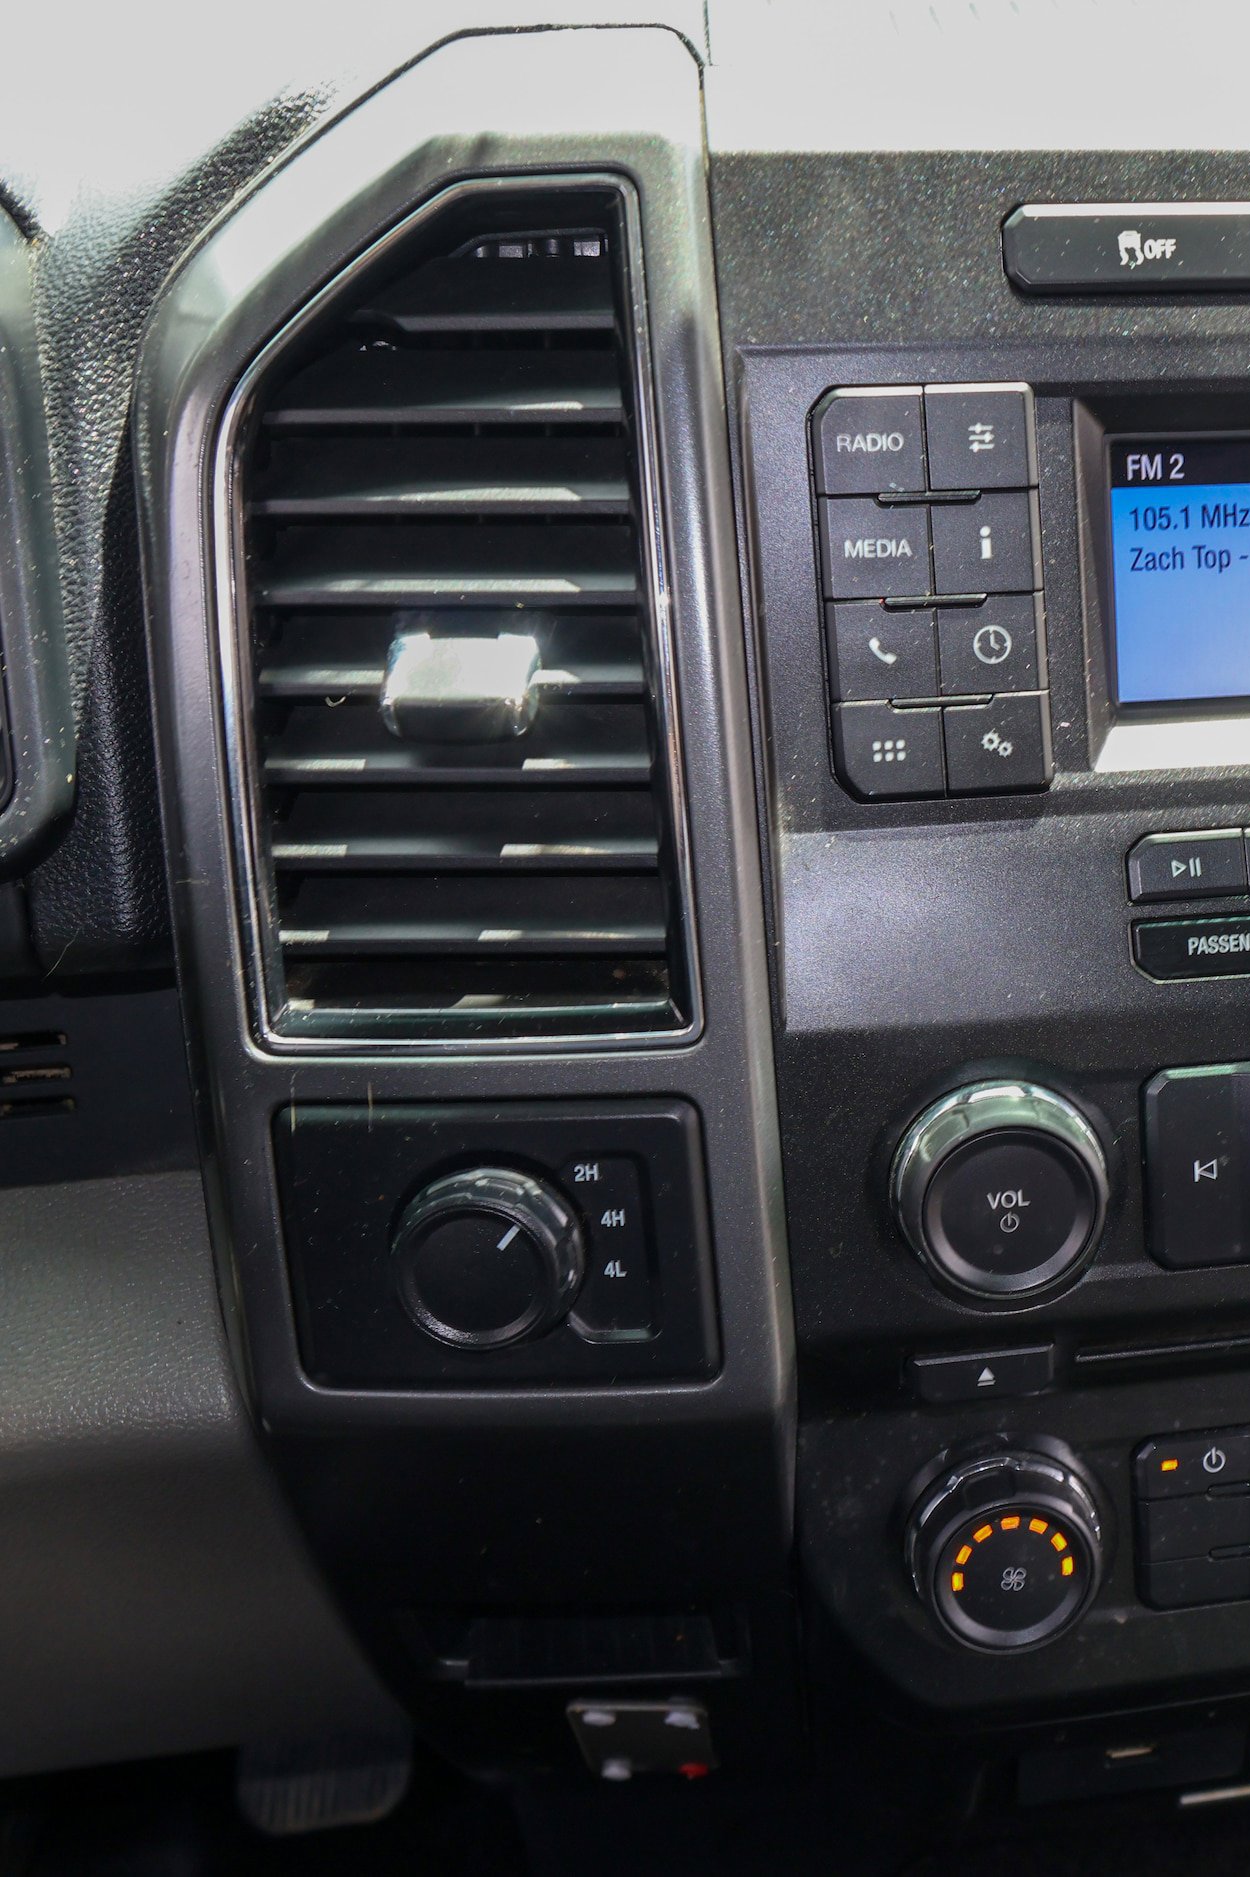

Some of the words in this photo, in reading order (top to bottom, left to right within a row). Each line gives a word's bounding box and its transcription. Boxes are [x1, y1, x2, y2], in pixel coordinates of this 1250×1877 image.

[1144, 238, 1176, 260] OFF
[836, 431, 905, 453] RADIO
[1126, 452, 1162, 481] FM
[1169, 453, 1185, 480] 2
[1129, 503, 1191, 532] 105.1
[1201, 502, 1250, 529] MHz
[844, 539, 913, 560] MEDIA
[1129, 545, 1185, 572] Zach
[1191, 544, 1231, 573] Top
[573, 1162, 600, 1182] 2H
[986, 1189, 1031, 1211] VOL
[600, 1208, 626, 1228] 4H
[603, 1260, 628, 1278] 4L
